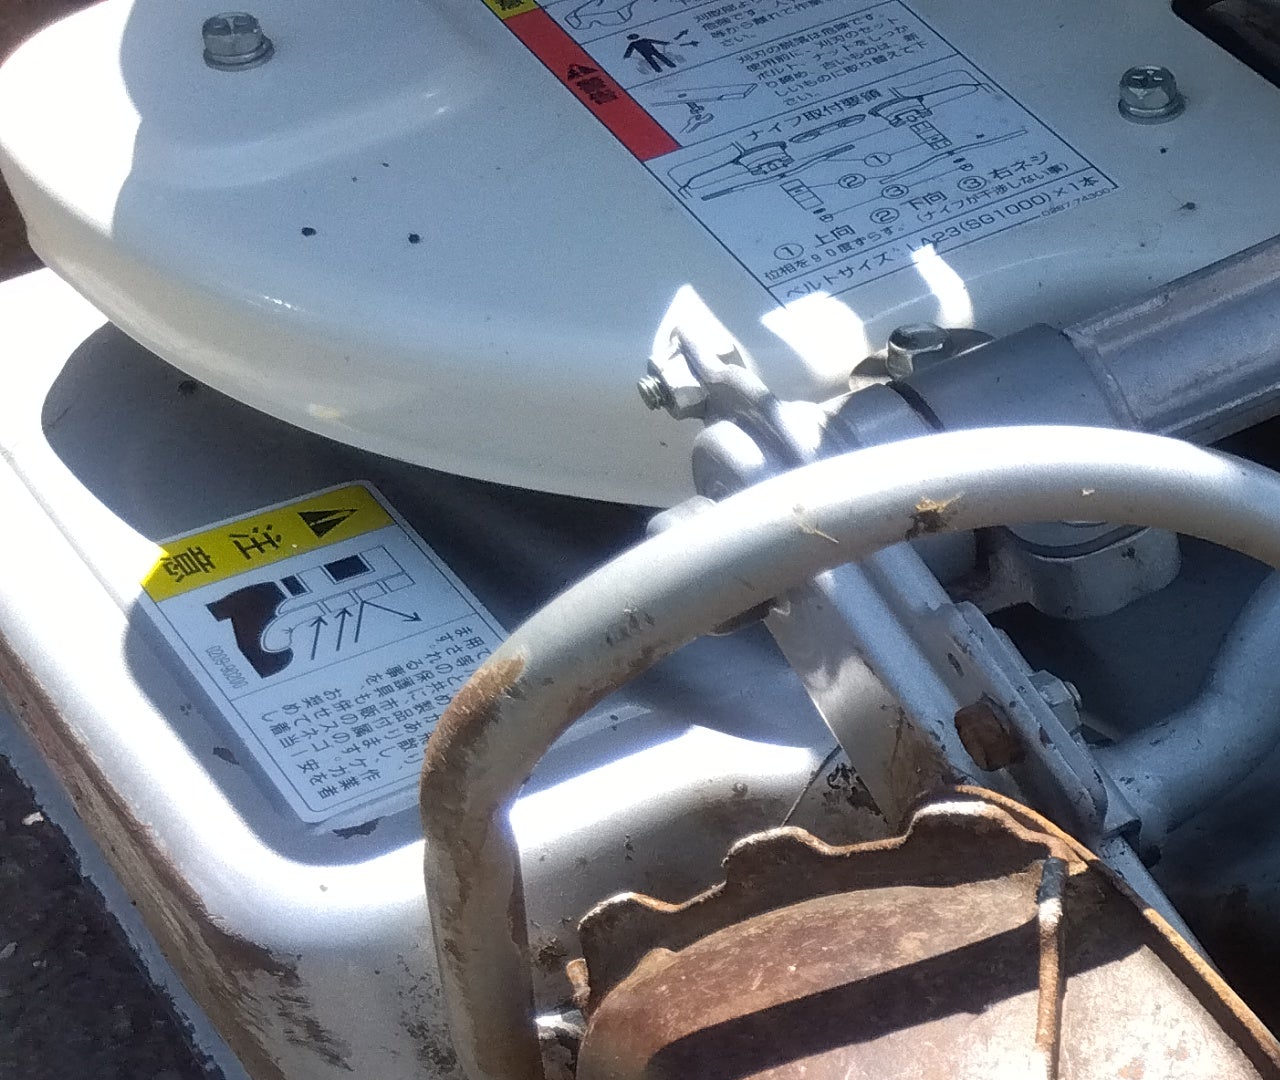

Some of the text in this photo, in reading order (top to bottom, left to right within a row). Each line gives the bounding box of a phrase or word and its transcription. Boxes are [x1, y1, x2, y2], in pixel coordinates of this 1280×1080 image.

[744, 88, 886, 141] ナイフ取付要領
[164, 524, 283, 583] 注意
